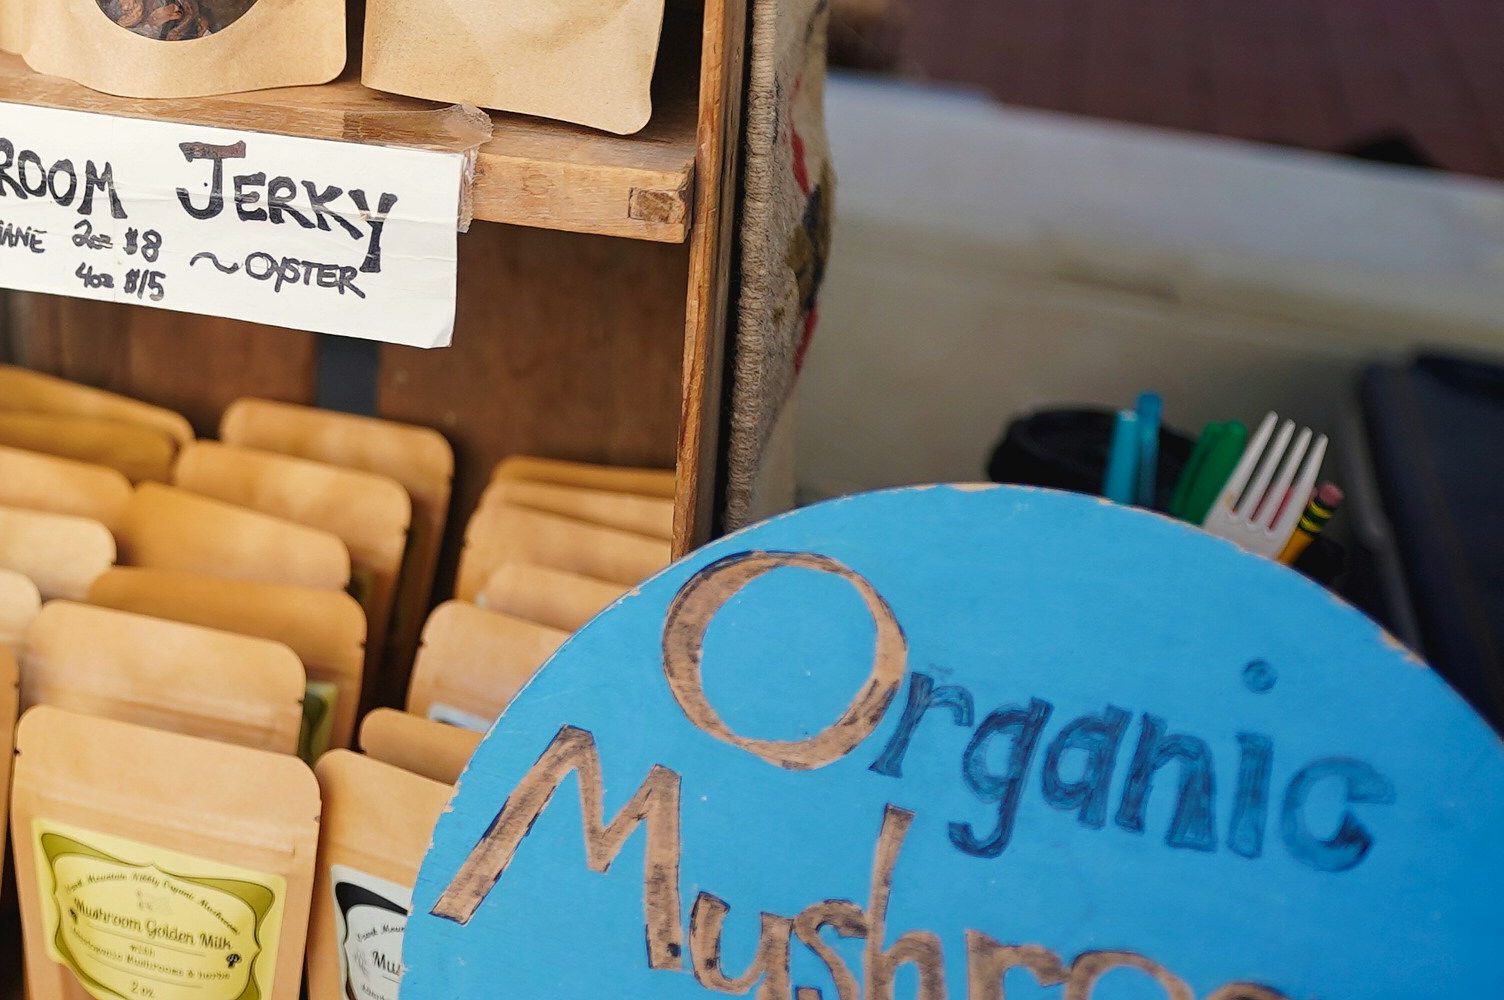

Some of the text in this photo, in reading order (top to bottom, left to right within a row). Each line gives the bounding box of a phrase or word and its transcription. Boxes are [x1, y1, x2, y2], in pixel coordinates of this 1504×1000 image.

[176, 139, 398, 274] JERKY
[123, 226, 164, 263] $8
[123, 267, 168, 302] $15
[245, 250, 366, 300] OYSTER
[661, 548, 1397, 872] Organic
[73, 896, 233, 951] Mushroom Golden Milk
